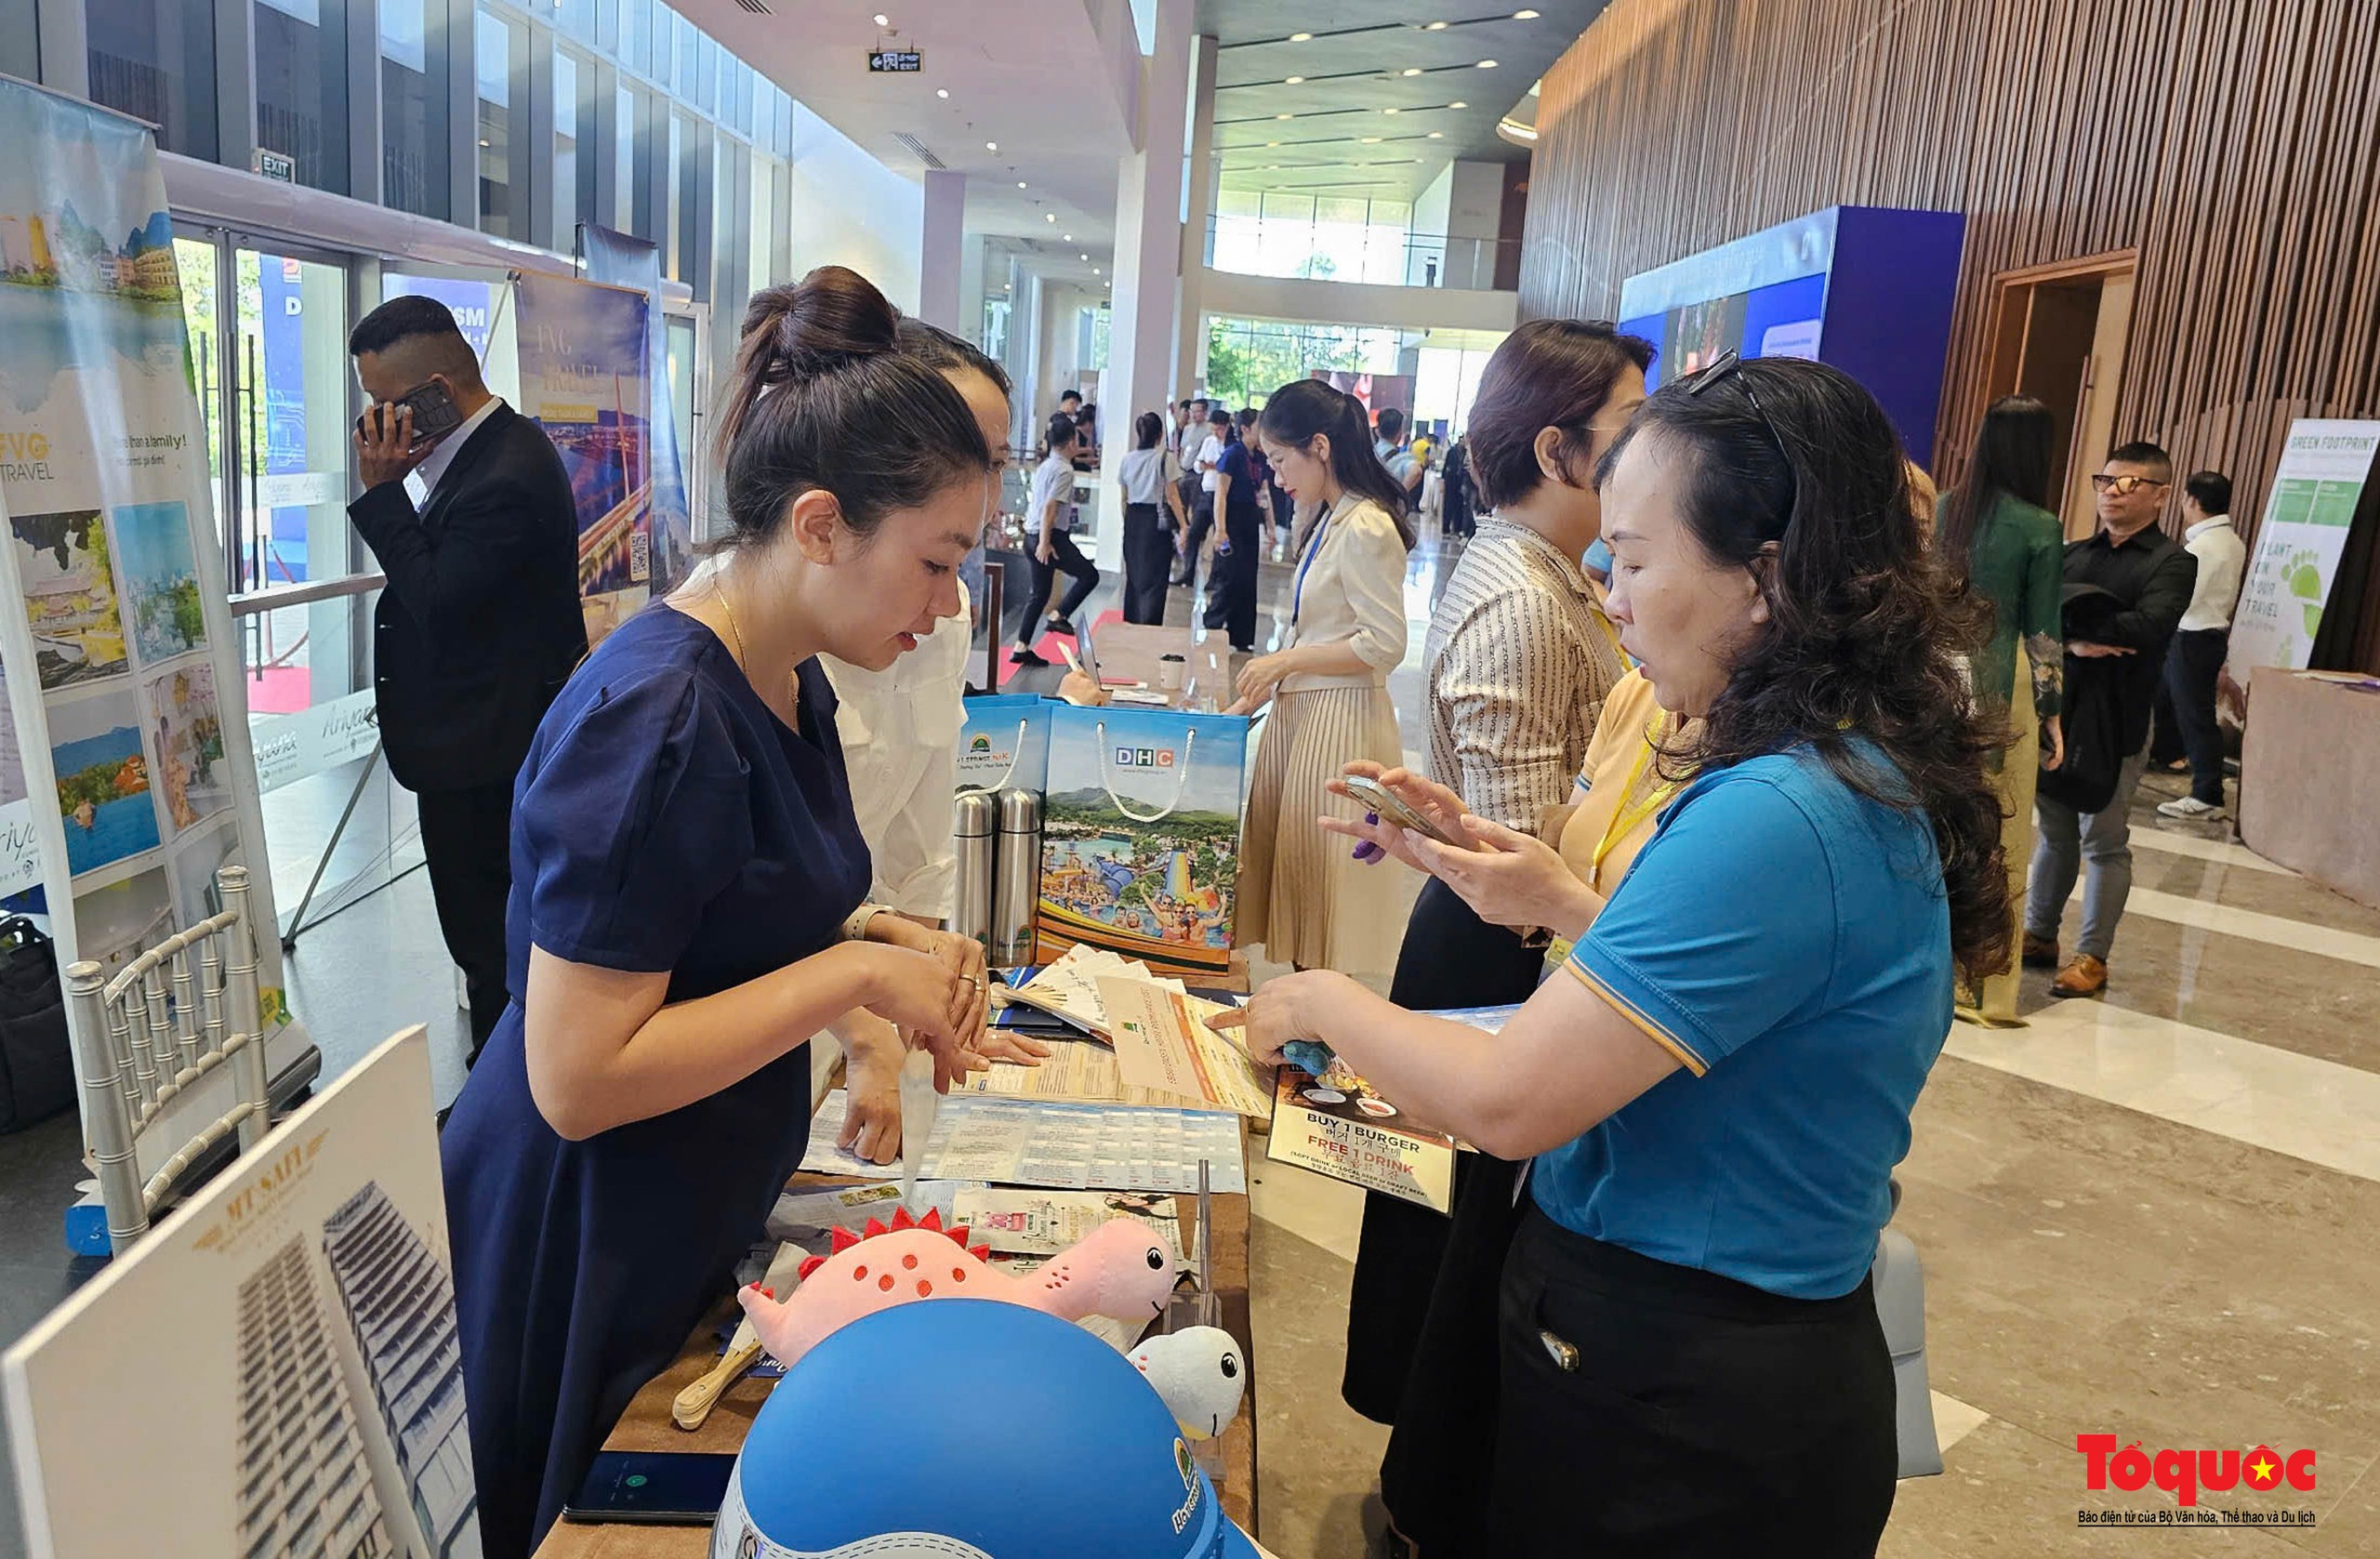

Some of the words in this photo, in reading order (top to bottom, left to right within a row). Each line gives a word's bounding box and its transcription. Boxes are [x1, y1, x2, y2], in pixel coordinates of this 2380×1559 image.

[263, 156, 289, 176] EXIT
[2290, 435, 2320, 450] GREEN
[2322, 436, 2376, 451] FOOTPRINT
[0, 462, 55, 483] TRAVEL
[2244, 599, 2278, 617] TRAVEL
[1117, 748, 1173, 766] DHC
[1307, 1113, 1339, 1129] BUY
[1344, 1123, 1350, 1132] 1
[1355, 1126, 1421, 1154] BURGER
[1308, 1135, 1348, 1155] FREE
[1353, 1149, 1358, 1158] 1
[1364, 1152, 1414, 1174] DRINK
[1339, 1165, 1360, 1175] LOCAL
